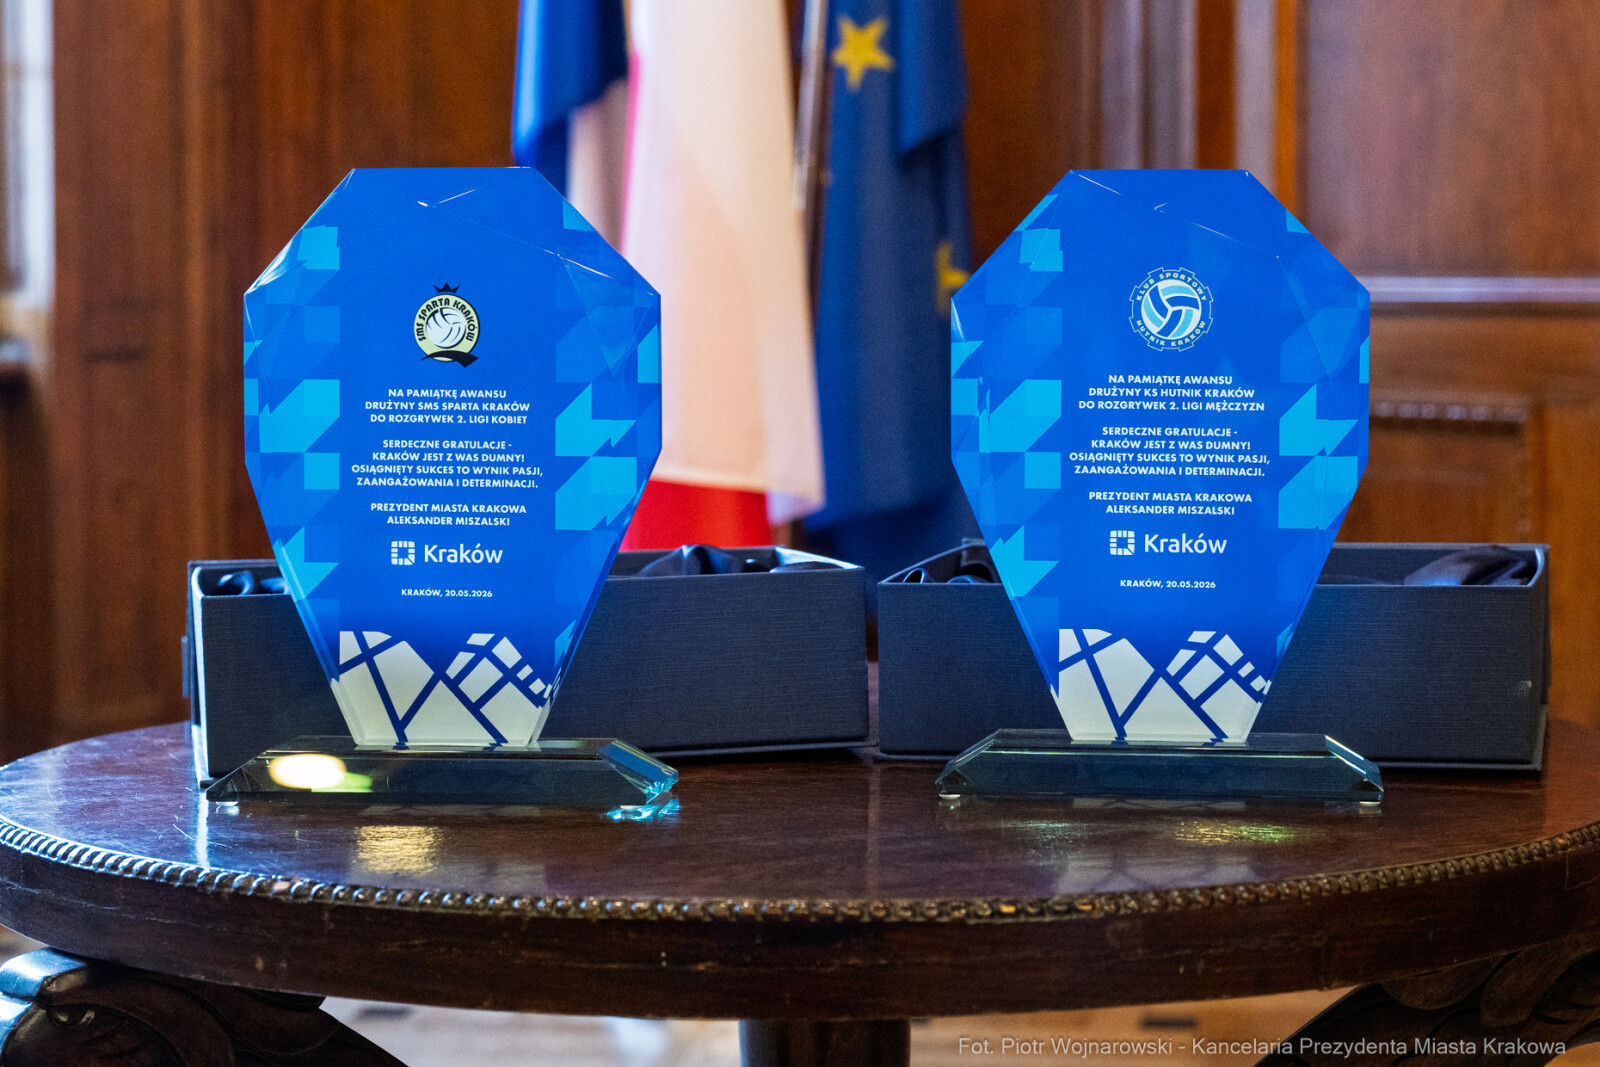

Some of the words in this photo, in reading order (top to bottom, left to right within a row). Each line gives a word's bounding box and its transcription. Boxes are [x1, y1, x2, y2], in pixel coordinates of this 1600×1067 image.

[1136, 279, 1155, 301] KLUB
[1159, 273, 1206, 300] SPORTOWY
[419, 298, 450, 320] SPARTA
[453, 300, 478, 341] KRAKÓW
[416, 322, 426, 341] SMS
[1136, 320, 1165, 345] HUTNIK
[1109, 375, 1125, 383] NA
[1128, 375, 1180, 385] PAMIĄTKĘ
[1183, 376, 1233, 384] AWANSU
[388, 389, 404, 398] NA
[407, 389, 458, 400] PAMIĄTKĘ
[460, 390, 506, 398] AWANSU
[1089, 385, 1141, 397] DRUŻYNY
[1144, 389, 1157, 397] KS
[1160, 389, 1202, 397] HUTNIK
[1205, 387, 1255, 398] KRAKÓW
[365, 399, 415, 410] DRUŻYNY
[418, 402, 439, 410] SMS
[442, 403, 479, 411] SPARTA
[482, 401, 530, 412] KRAKÓW
[1079, 401, 1095, 409] DO
[1098, 401, 1166, 410] ROZGRYWEK
[1169, 402, 1179, 410] 2.
[1182, 402, 1202, 410] LIGI
[1205, 400, 1265, 412] MĘŻCZYZN
[370, 414, 386, 422] DO
[389, 415, 454, 423] ROZGRYWEK
[457, 415, 466, 424] 2.
[469, 415, 488, 424] LIGI
[492, 416, 527, 424] KOBIET
[1102, 427, 1162, 436] SERDECZNE
[1165, 428, 1231, 437] GRATULACJE
[383, 440, 440, 448] SERDECZNE
[442, 440, 506, 449] GRATULACJE
[1091, 438, 1141, 448] KRAKÓW
[1144, 440, 1166, 449] JEST
[1169, 441, 1175, 449] Z
[1178, 441, 1203, 449] WAS
[1206, 441, 1250, 450] DUMNY!
[372, 450, 419, 461] KRAKÓW
[422, 453, 444, 461] JEST
[446, 453, 453, 461] Z
[455, 454, 479, 462] WAS
[481, 454, 525, 462] DUMNY!
[1069, 453, 1133, 463] OSIĄGNIĘTY
[1137, 453, 1177, 462] SUKCES
[1179, 454, 1193, 463] TO
[1196, 454, 1235, 463] WYNIK
[1238, 454, 1270, 465] PASJI,
[352, 465, 414, 475] OSIĄGNIĘTY
[416, 466, 454, 474] SUKCES
[457, 466, 470, 474] TO
[473, 466, 509, 475] WYNIK
[512, 467, 543, 477] PASJI,
[1074, 463, 1176, 475] ZAANGAŻOWANIA
[1179, 467, 1182, 475] I
[1185, 467, 1265, 477] DETERMINACJI.
[356, 476, 453, 487] ZAANGAŻOWANIA
[456, 479, 459, 487] I
[462, 479, 538, 488] DETERMINACJI.
[1089, 492, 1149, 500] PREZYDENT
[1152, 493, 1192, 501] MIASTA
[1195, 493, 1252, 502] KRAKOWA
[371, 503, 429, 512] PREZYDENT
[431, 504, 469, 512] MIASTA
[472, 504, 526, 513] KRAKOWA
[1106, 505, 1175, 514] ALEKSANDER
[1178, 506, 1235, 515] MISZALSKI
[387, 516, 452, 525] ALEKSANDER
[455, 517, 510, 526] MISZALSKI
[1144, 533, 1227, 554] Kraków
[424, 543, 503, 563] Kraków
[1120, 579, 1164, 588] KRAKÓW,
[1166, 581, 1216, 589] 20.05.2026
[401, 587, 442, 597] KRAKÓW,
[445, 589, 492, 597] 20.05.2026
